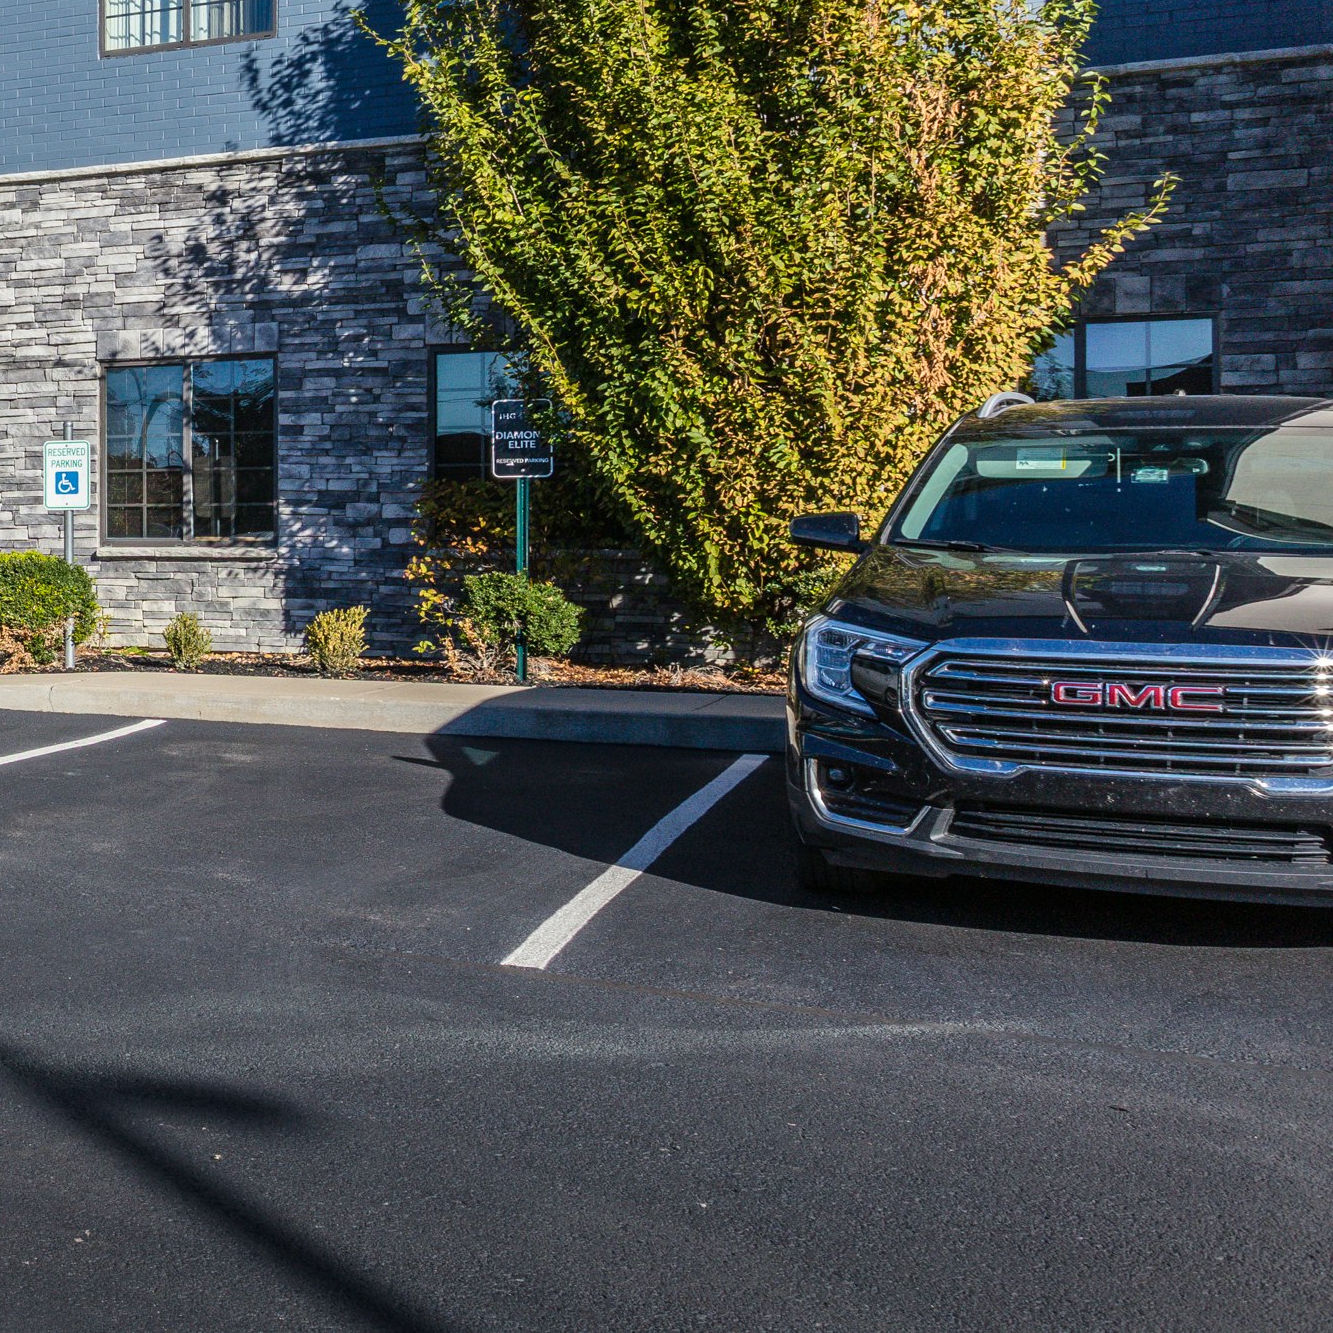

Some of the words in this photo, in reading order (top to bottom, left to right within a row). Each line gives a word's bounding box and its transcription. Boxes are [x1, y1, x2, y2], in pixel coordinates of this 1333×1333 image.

[495, 430, 540, 440] DIAMON
[508, 440, 536, 449] ELITE
[47, 447, 86, 457] RESERVED
[51, 459, 83, 468] PARKING
[1051, 680, 1225, 711] GMC
